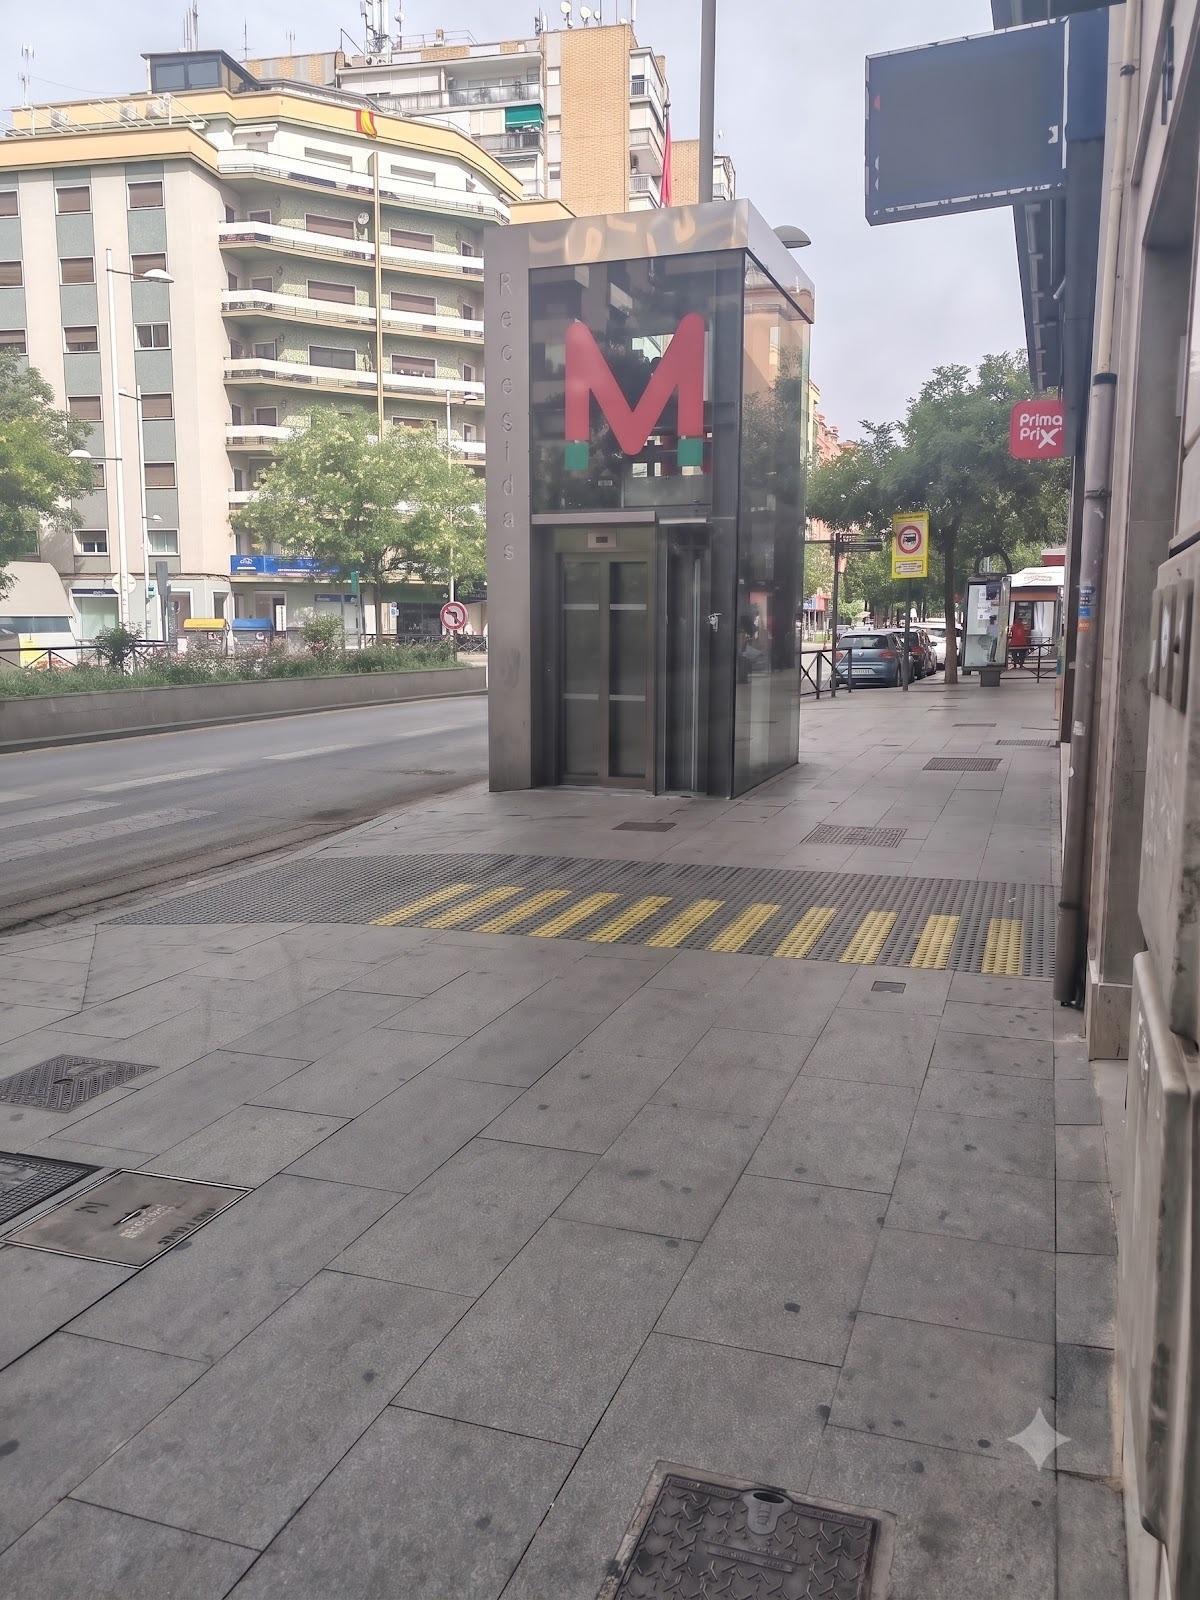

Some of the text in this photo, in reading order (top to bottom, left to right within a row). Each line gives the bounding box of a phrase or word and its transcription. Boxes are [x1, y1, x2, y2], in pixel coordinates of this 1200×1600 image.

[564, 312, 706, 471] M
[1019, 413, 1063, 427] Prima
[1019, 427, 1060, 449] PriX
